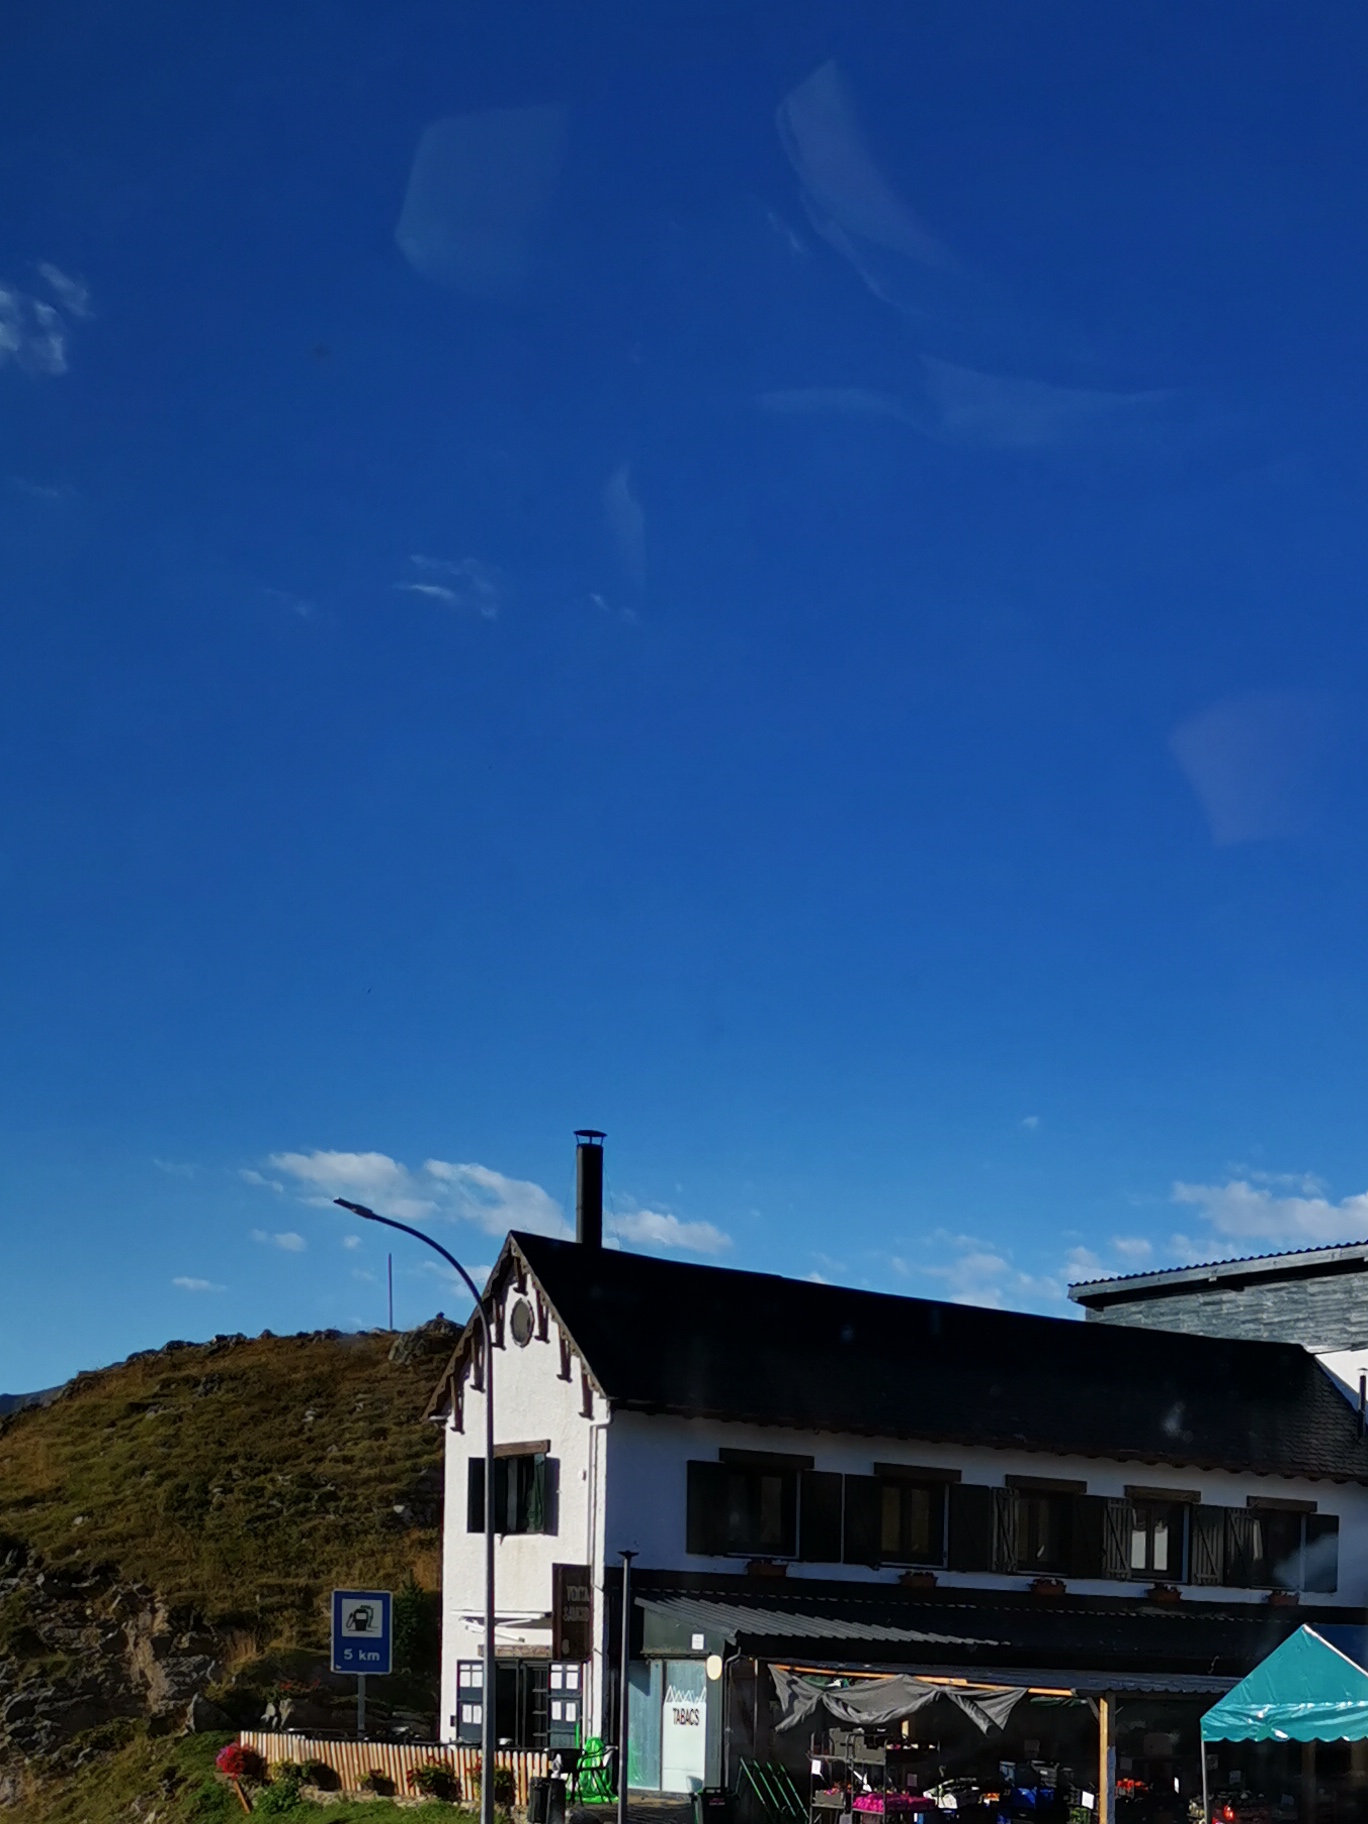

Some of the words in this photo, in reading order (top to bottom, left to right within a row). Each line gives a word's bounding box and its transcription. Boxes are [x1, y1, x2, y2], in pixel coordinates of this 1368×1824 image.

[343, 1647, 354, 1661] 5
[358, 1648, 381, 1661] km
[672, 1707, 700, 1726] TABACS
